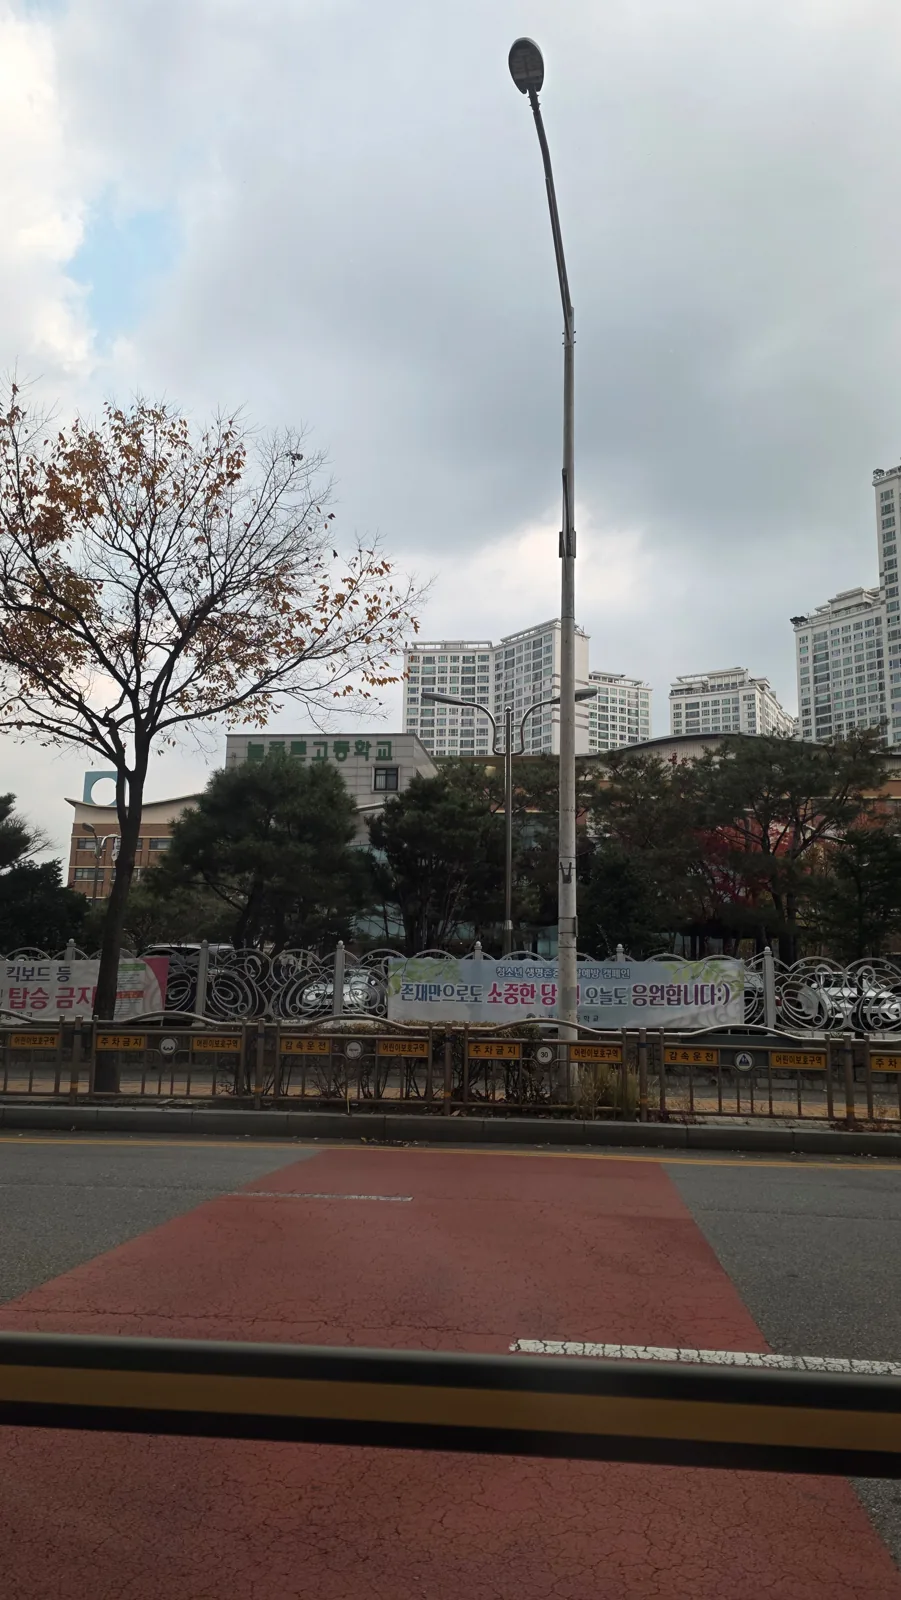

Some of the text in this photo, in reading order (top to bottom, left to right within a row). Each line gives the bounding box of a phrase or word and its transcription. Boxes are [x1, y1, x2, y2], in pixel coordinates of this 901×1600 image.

[6, 966, 72, 982] 킥보드 등
[496, 967, 523, 979] 청소년
[602, 968, 631, 980] 캠페인
[9, 987, 50, 1009] 탑승
[55, 986, 98, 1009] 금지
[400, 983, 483, 1003] 존재만으로도
[487, 983, 536, 1006] 소중한
[585, 986, 628, 1006] 오늘도
[14, 1035, 55, 1046] 어린이보호구역
[100, 1037, 142, 1047] 주차금지
[196, 1039, 238, 1049] 어린이보호구역
[284, 1040, 326, 1051] 감속운전
[382, 1042, 425, 1053] 어린이보호구역
[472, 1045, 516, 1055] 주차금지
[574, 1048, 618, 1058] 어린이보호구역
[540, 1051, 549, 1059] 30
[669, 1051, 714, 1062] 감속운전
[775, 1055, 822, 1066] 어린이보호구역
